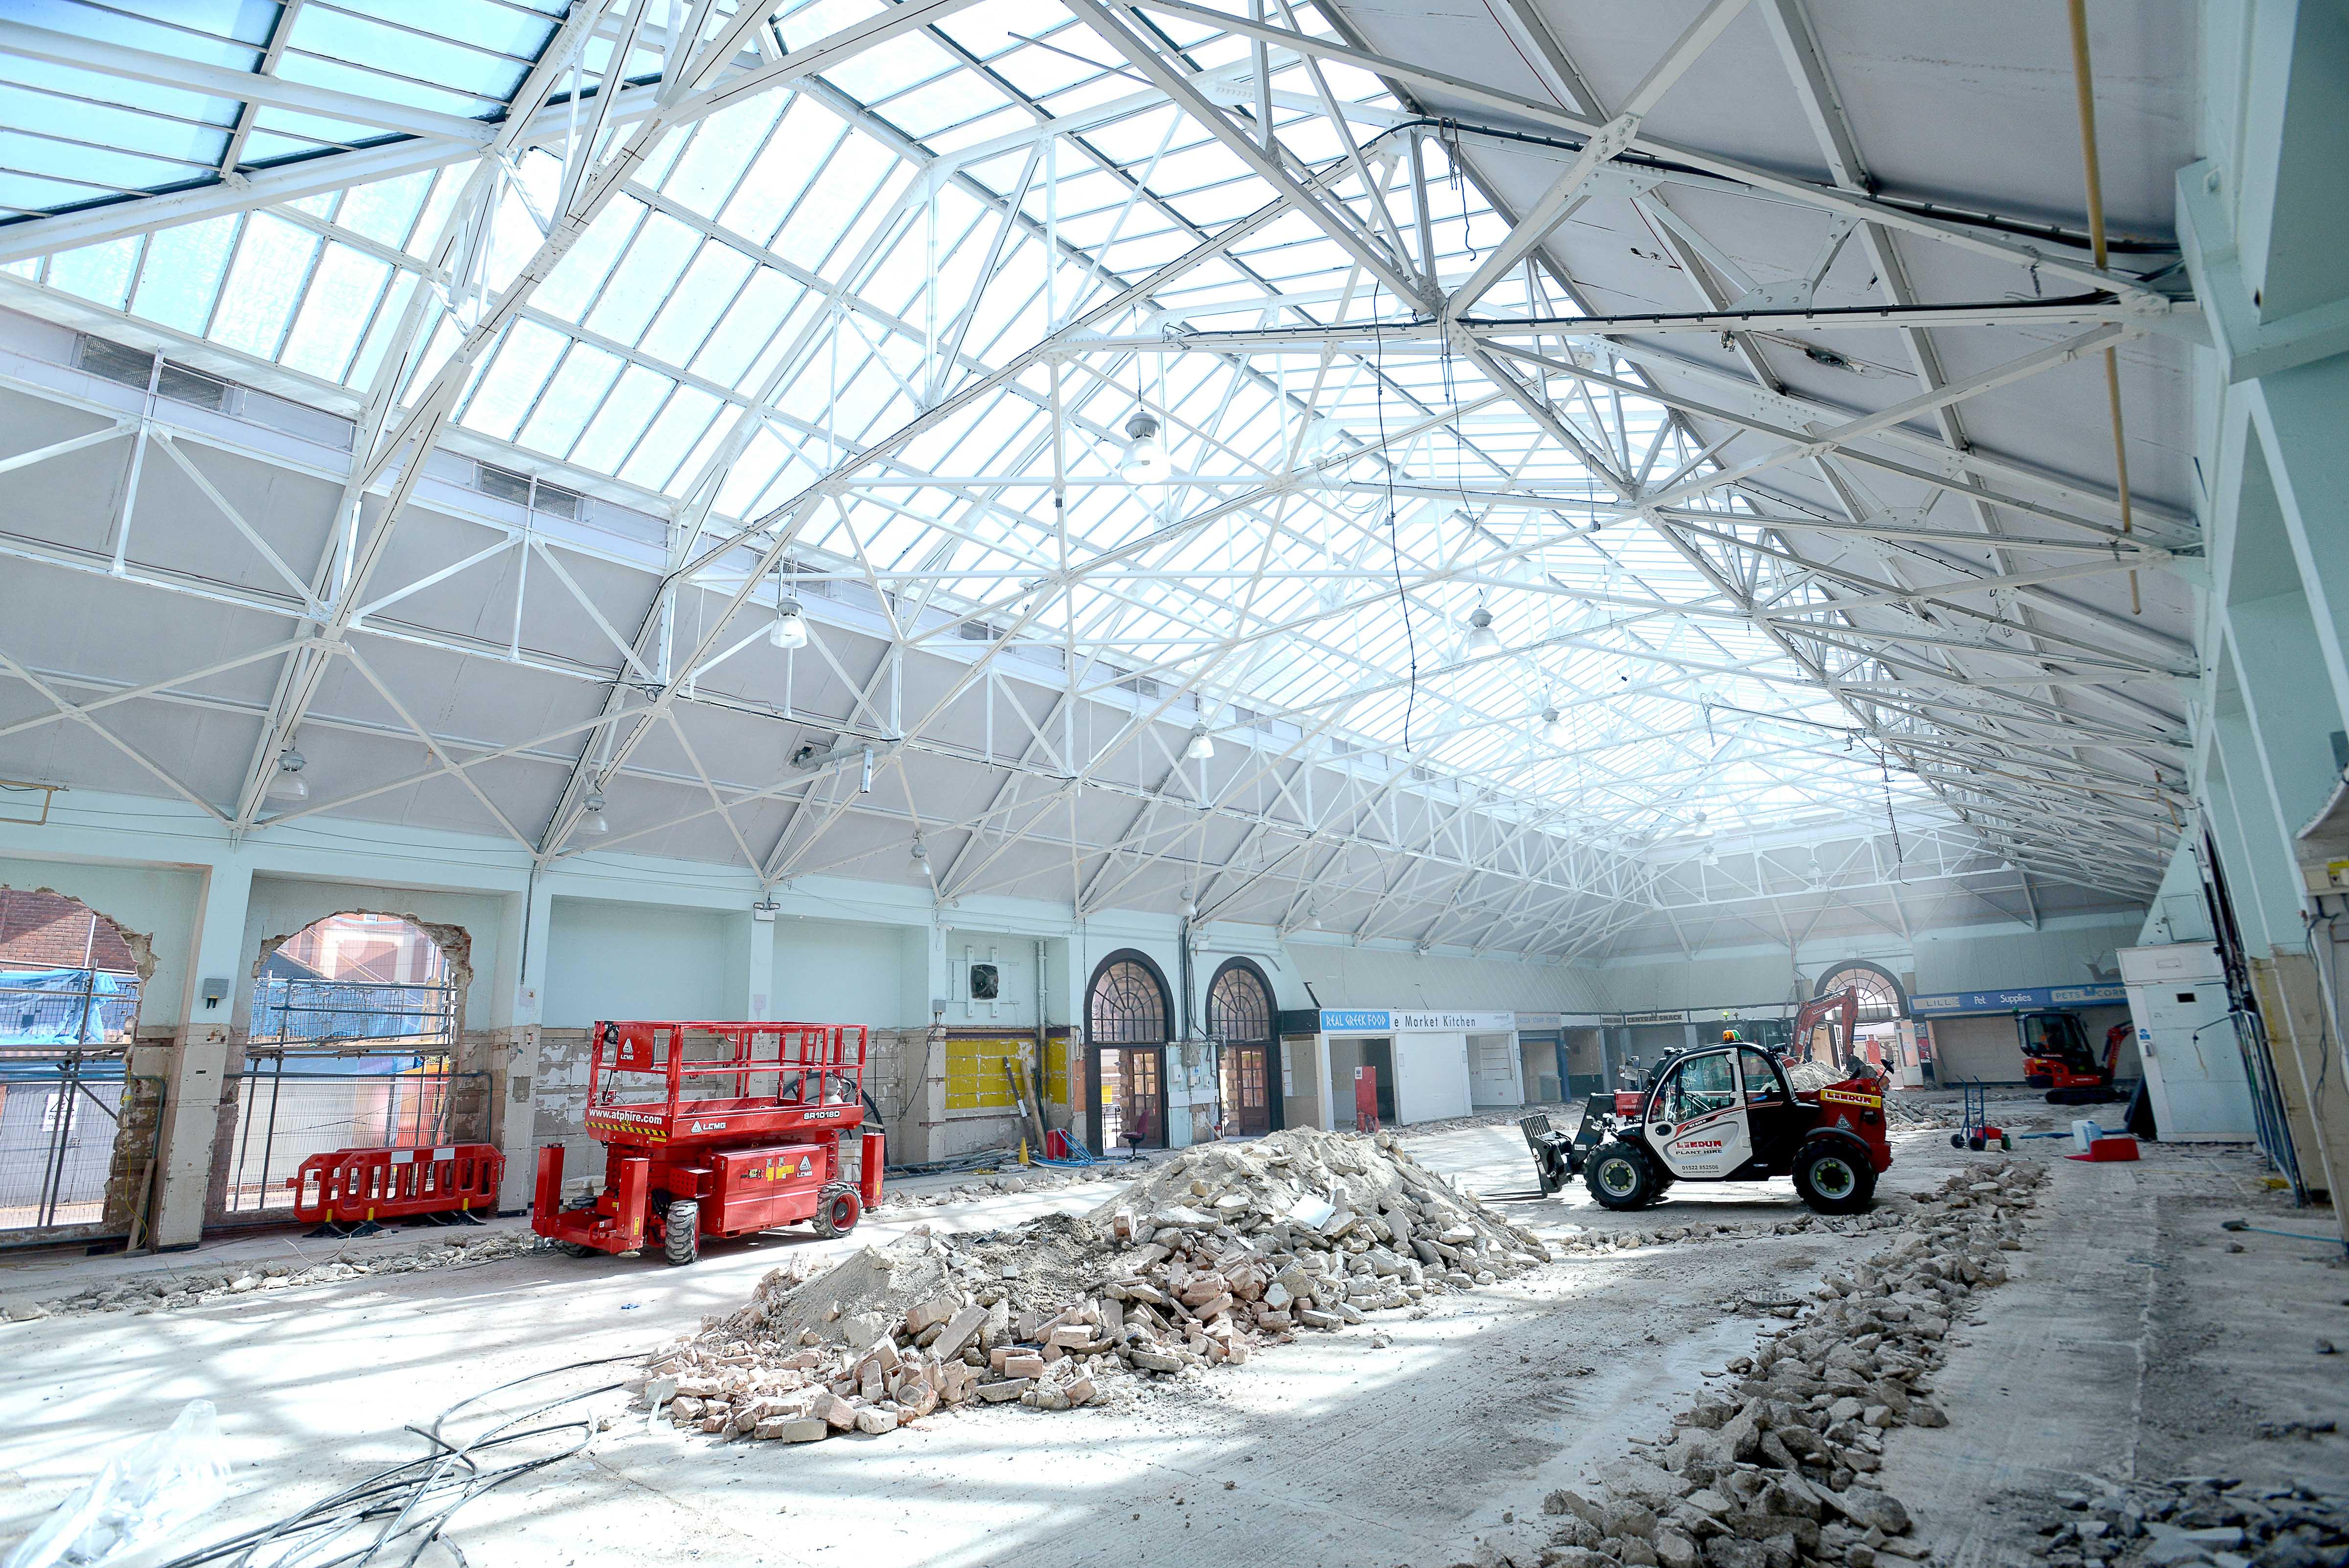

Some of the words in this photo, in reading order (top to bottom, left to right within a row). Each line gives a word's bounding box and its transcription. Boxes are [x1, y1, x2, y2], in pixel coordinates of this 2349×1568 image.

[1974, 995, 1986, 1005] Pet
[2000, 993, 2032, 1004] Supplies
[1326, 1015, 1344, 1027] REAL
[1345, 1014, 1366, 1027] GREEK
[1367, 1014, 1386, 1027] FOOD
[1394, 1018, 1399, 1027] e
[1405, 1015, 1438, 1027] Market
[1443, 1015, 1476, 1027] Kitchen
[589, 1108, 662, 1125] www.atphire.com
[804, 1110, 840, 1120] SR1018D
